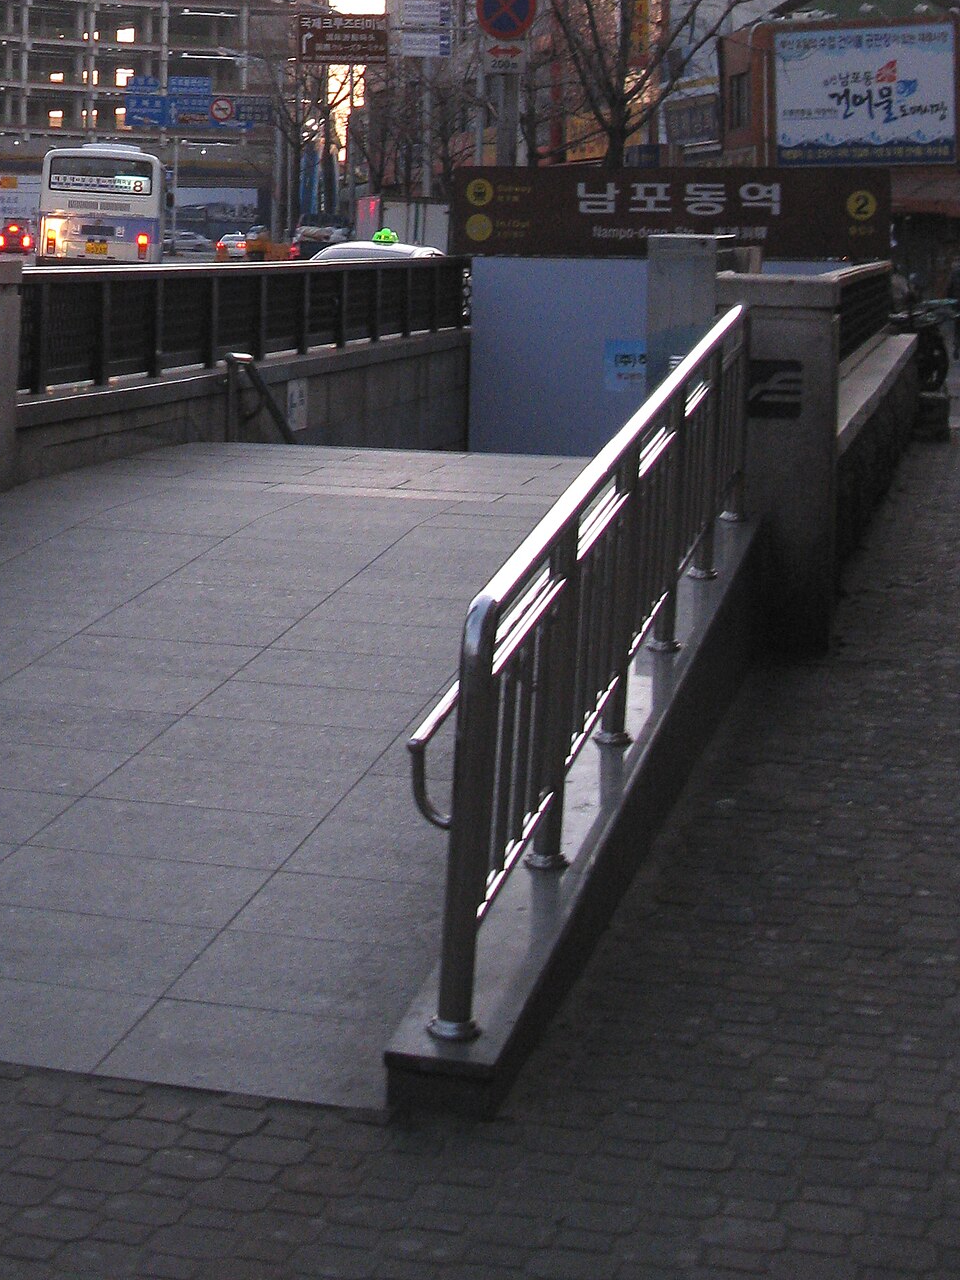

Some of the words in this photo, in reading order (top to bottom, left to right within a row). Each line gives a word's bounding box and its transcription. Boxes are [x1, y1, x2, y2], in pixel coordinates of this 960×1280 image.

[828, 86, 898, 124] 건어물
[133, 180, 144, 193] 8
[576, 181, 781, 217] 남포동역
[855, 195, 869, 215] 2
